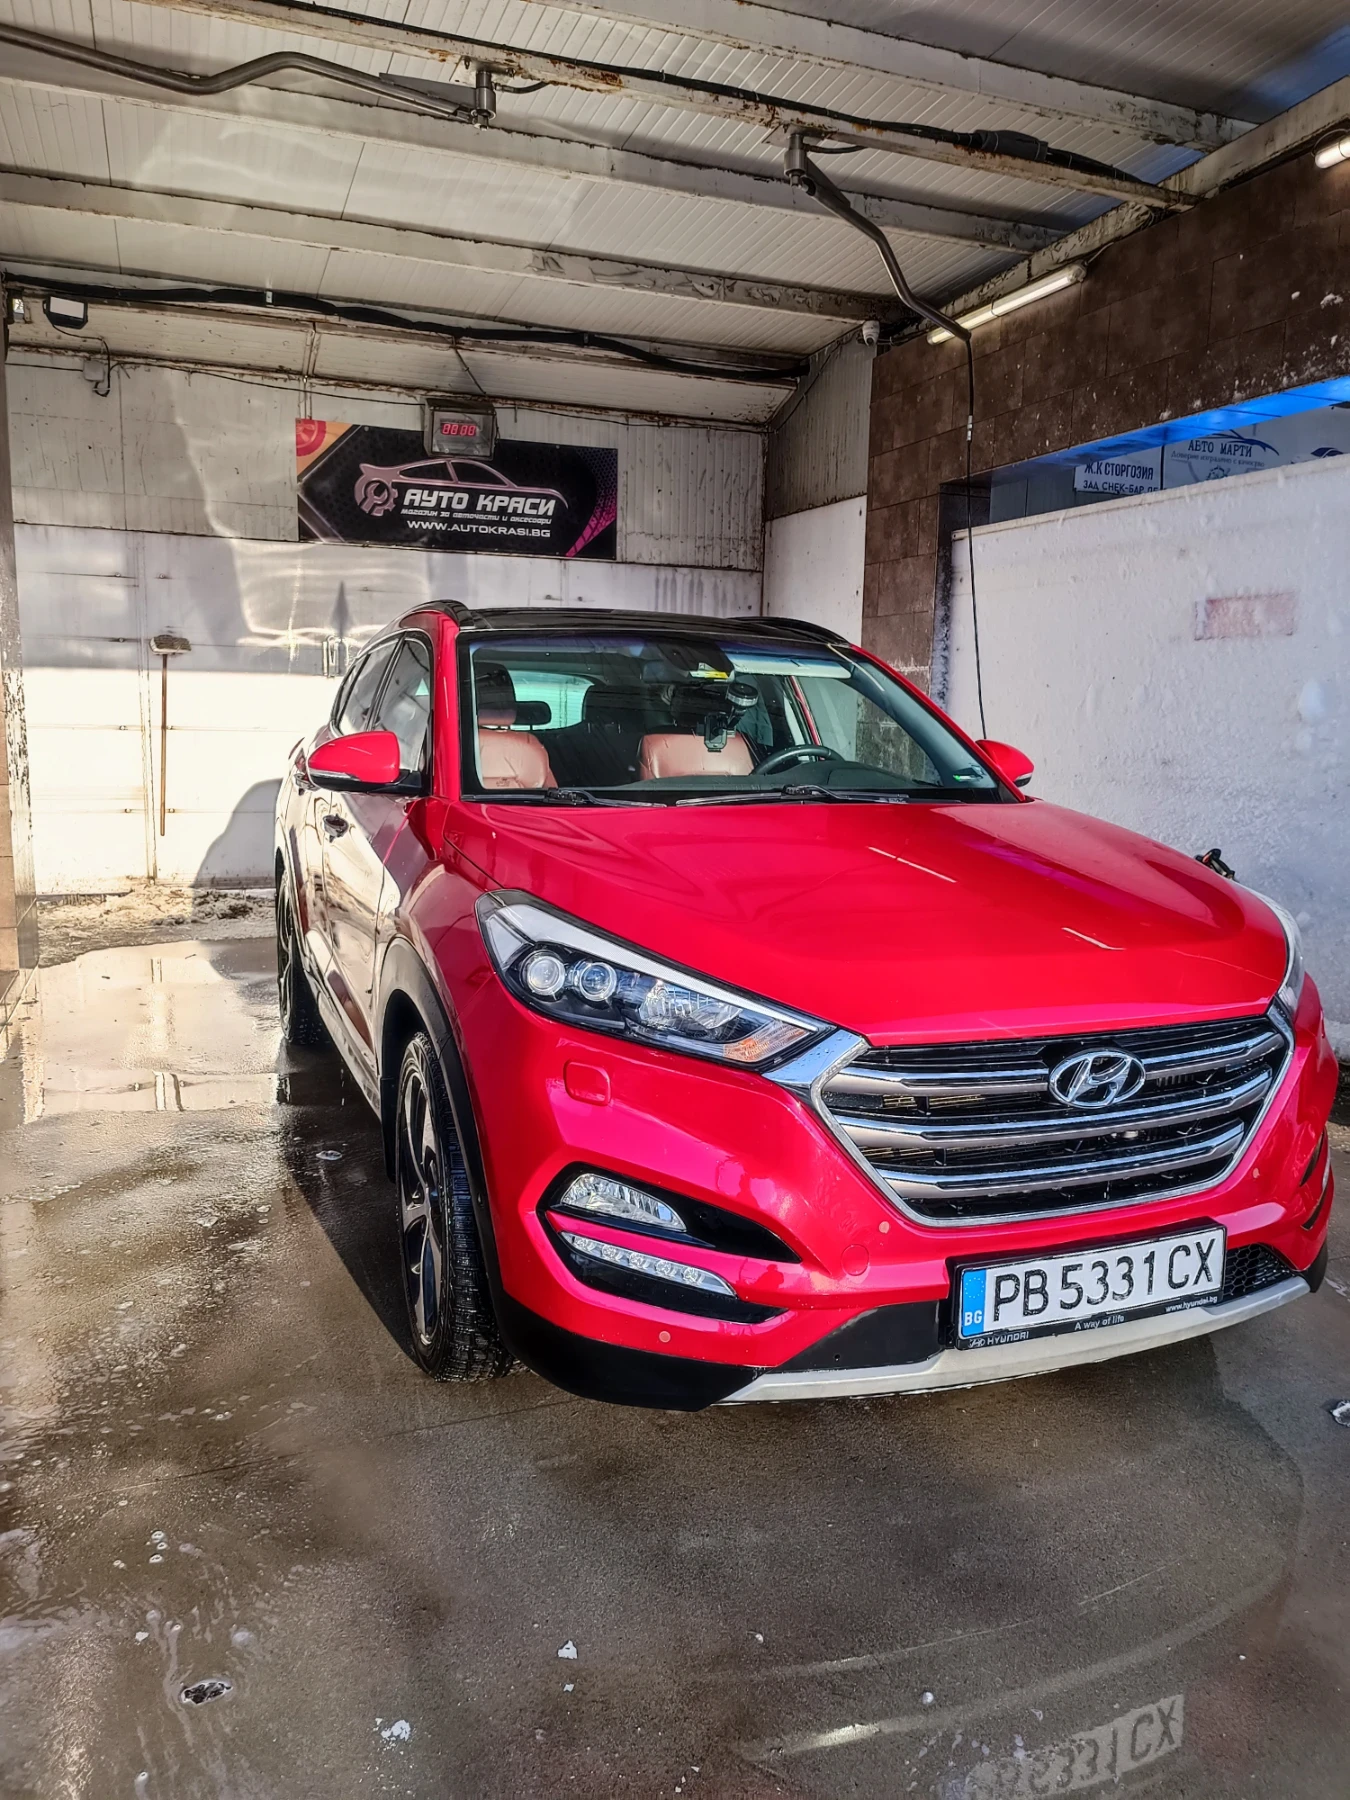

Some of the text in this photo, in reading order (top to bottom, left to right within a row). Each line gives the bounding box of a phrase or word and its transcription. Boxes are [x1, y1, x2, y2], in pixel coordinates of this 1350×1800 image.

[1188, 440, 1252, 457] АВТО МАРТИ
[1104, 462, 1154, 480] СТОРГОЗИЯ
[1083, 480, 1099, 490] ЗАД
[1102, 482, 1144, 493] СНЕК-БАР
[403, 488, 556, 515] АУТО КРАСИ
[406, 520, 551, 537] WWW.AUTOKRASI.BG
[993, 1238, 1216, 1321] PB 5331 CX
[1165, 1295, 1218, 1313] www.hyundai.bg
[964, 1310, 983, 1326] BG
[1074, 1314, 1125, 1331] A way of life
[986, 1331, 1029, 1346] HYUNDAI
